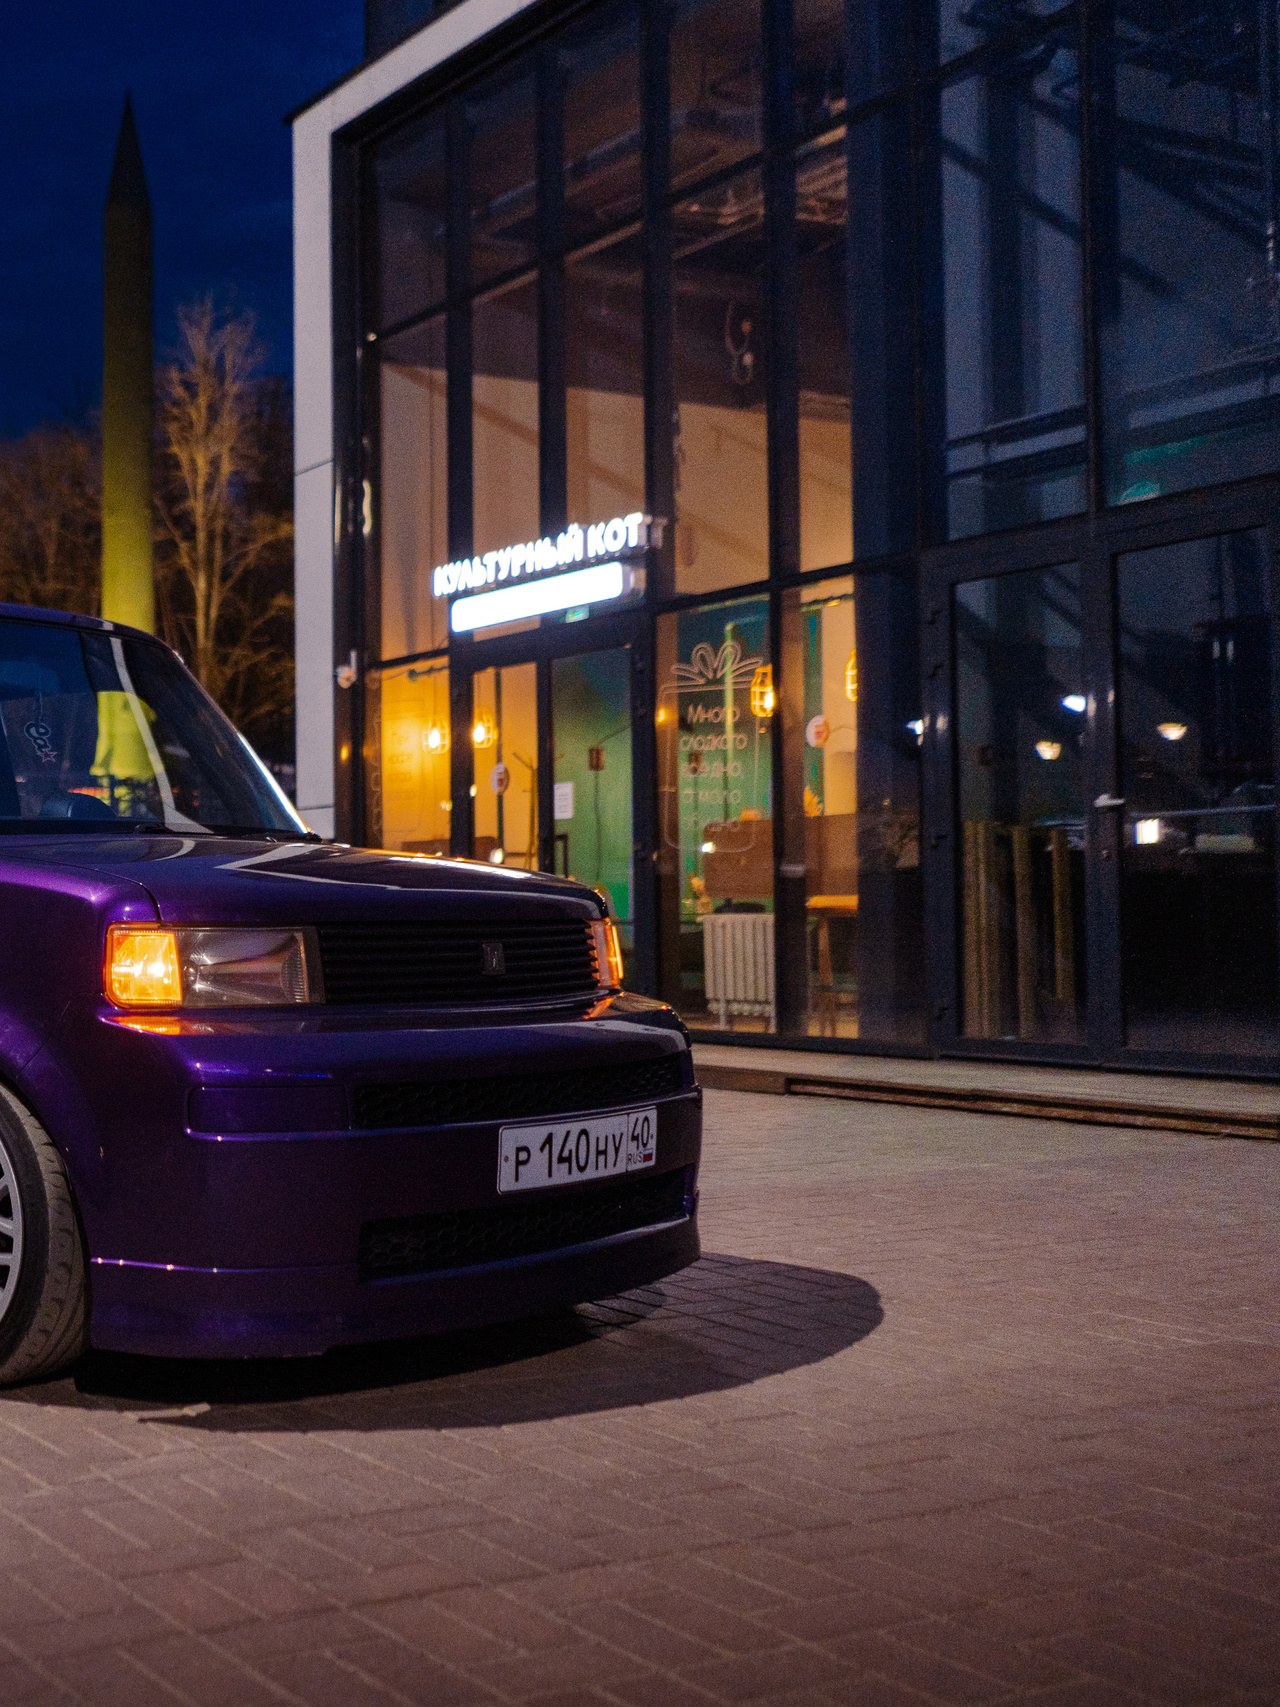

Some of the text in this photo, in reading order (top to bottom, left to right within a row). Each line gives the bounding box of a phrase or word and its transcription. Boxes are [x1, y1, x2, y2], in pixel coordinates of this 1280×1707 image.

[433, 511, 643, 597] КУЛЬТУРНЫЙ КОТ
[631, 1116, 650, 1150] 40
[628, 1151, 643, 1165] RUS
